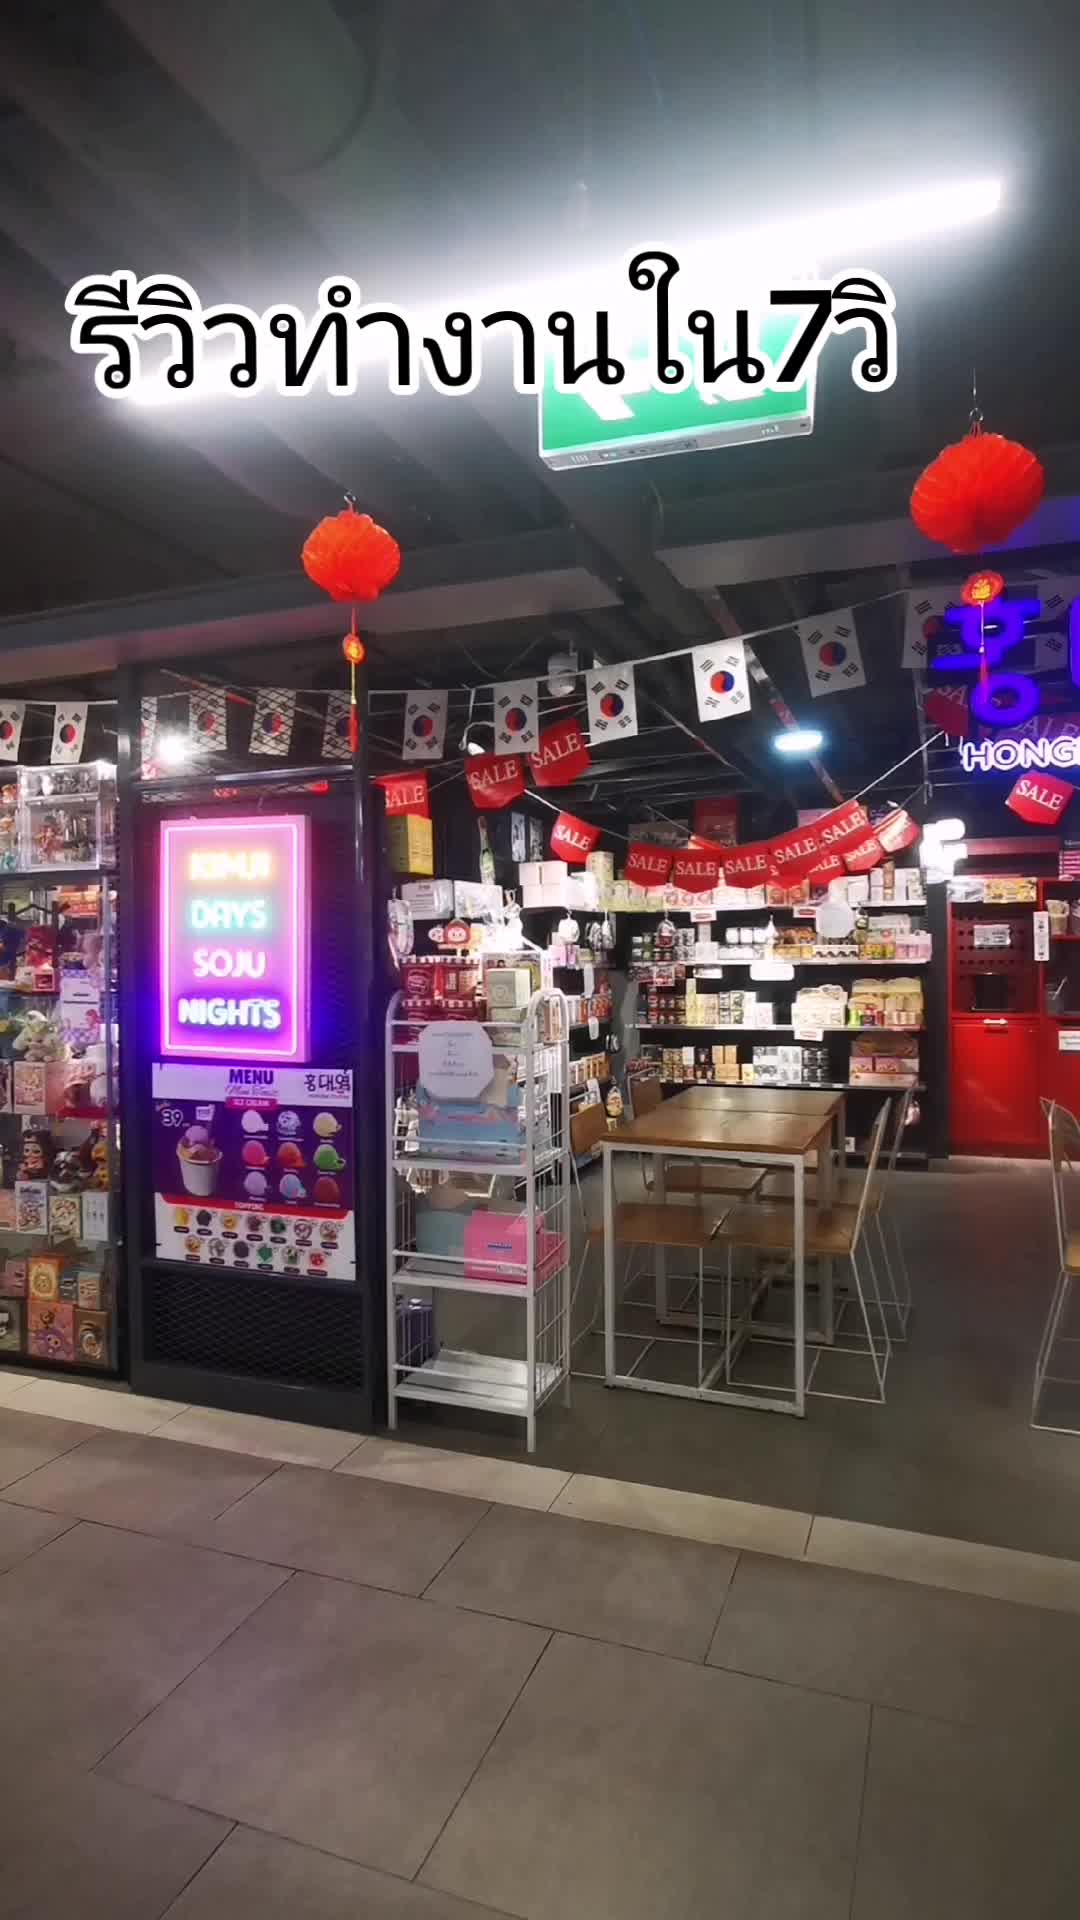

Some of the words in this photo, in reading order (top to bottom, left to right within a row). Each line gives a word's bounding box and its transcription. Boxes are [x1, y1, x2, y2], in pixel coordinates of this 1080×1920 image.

[931, 597, 1080, 726] 홍
[531, 734, 581, 769] SALE
[963, 736, 1080, 772] HONG
[469, 760, 519, 790] SALE
[1016, 779, 1063, 810] SALE
[554, 825, 592, 850] SALE
[822, 810, 866, 844] SALE
[628, 853, 670, 873] SALE
[725, 854, 767, 874] SALE
[774, 836, 818, 864] SALE
[675, 859, 717, 876] SALE
[190, 898, 267, 929] DAYS
[192, 948, 266, 978] SOJU
[178, 998, 281, 1029] NIGHTS
[229, 1069, 274, 1085] MENU
[161, 1109, 184, 1127] 39
